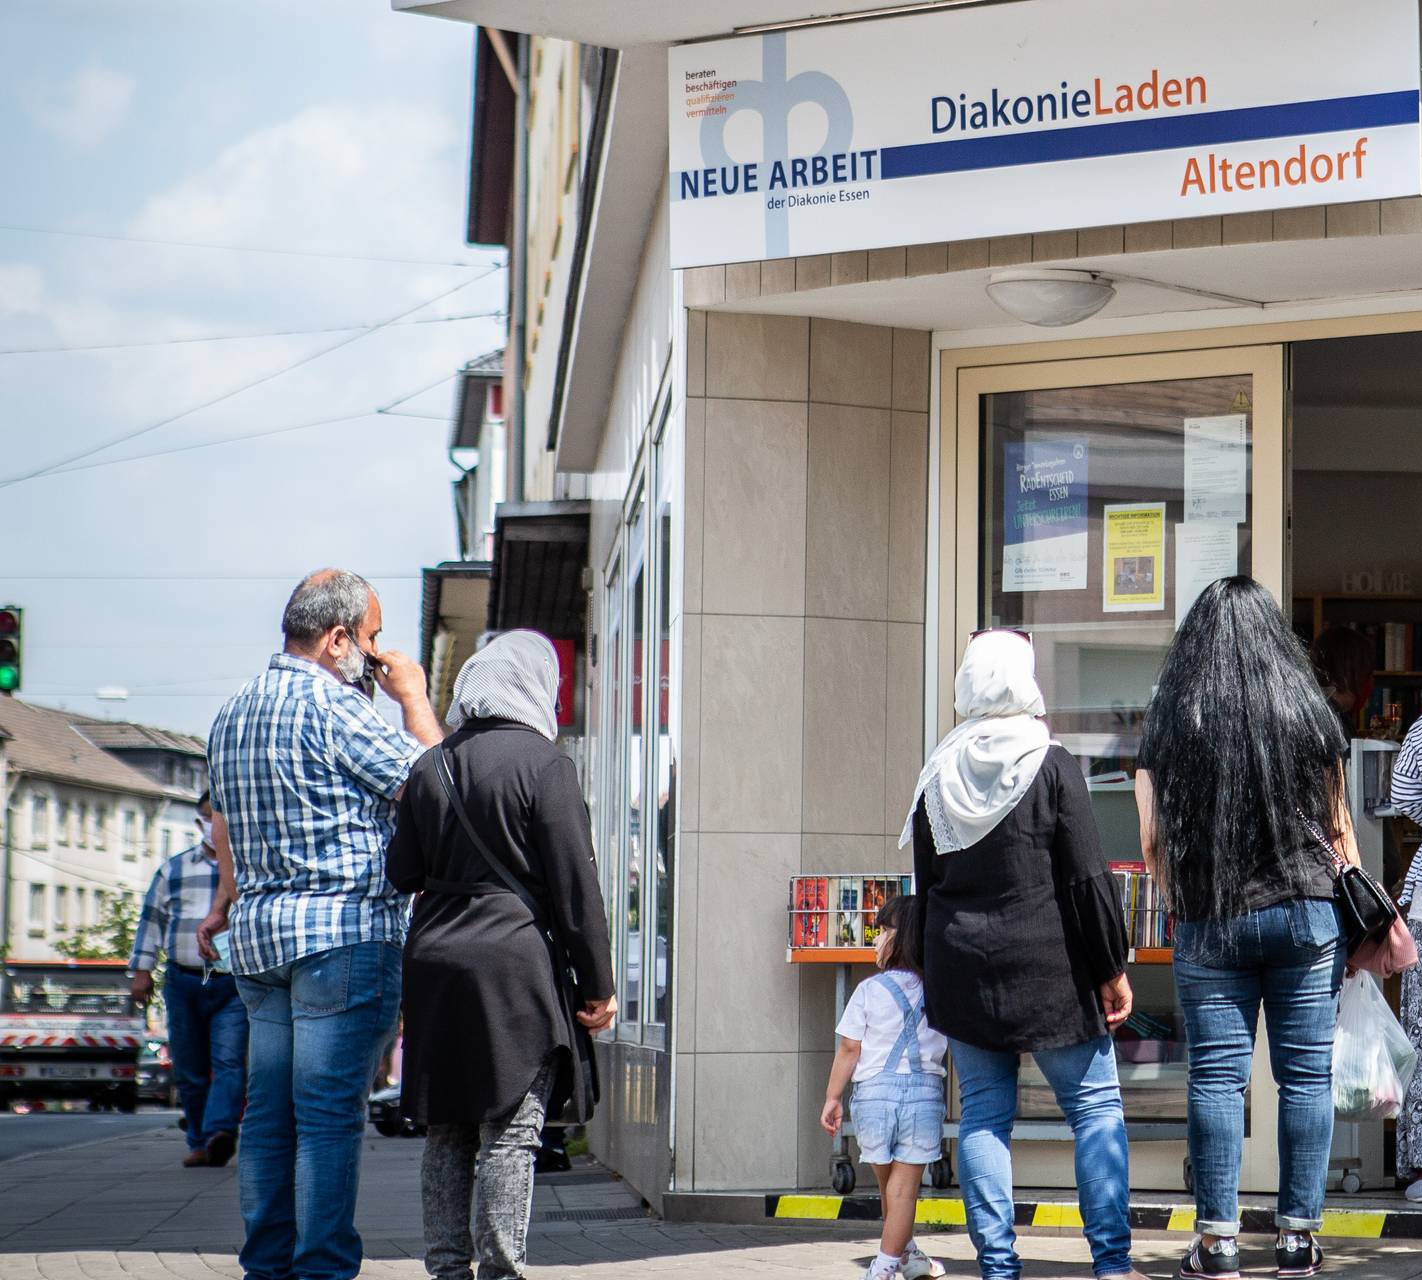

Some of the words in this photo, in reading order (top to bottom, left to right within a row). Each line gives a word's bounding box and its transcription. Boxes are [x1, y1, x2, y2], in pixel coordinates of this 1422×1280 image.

[685, 69, 716, 80] beraten
[685, 79, 737, 93] beschäftigen
[686, 93, 736, 106] qualifizieren
[931, 68, 1207, 134] DiakonieLaden
[686, 106, 727, 118] vermitteln
[680, 163, 758, 200] NEUE
[769, 150, 877, 190] ARBEIT
[1180, 137, 1368, 197] Altendorf
[767, 197, 785, 209] der
[788, 191, 836, 207] Diakonie
[839, 189, 870, 202] Essen
[1049, 486, 1069, 502] ESSEN
